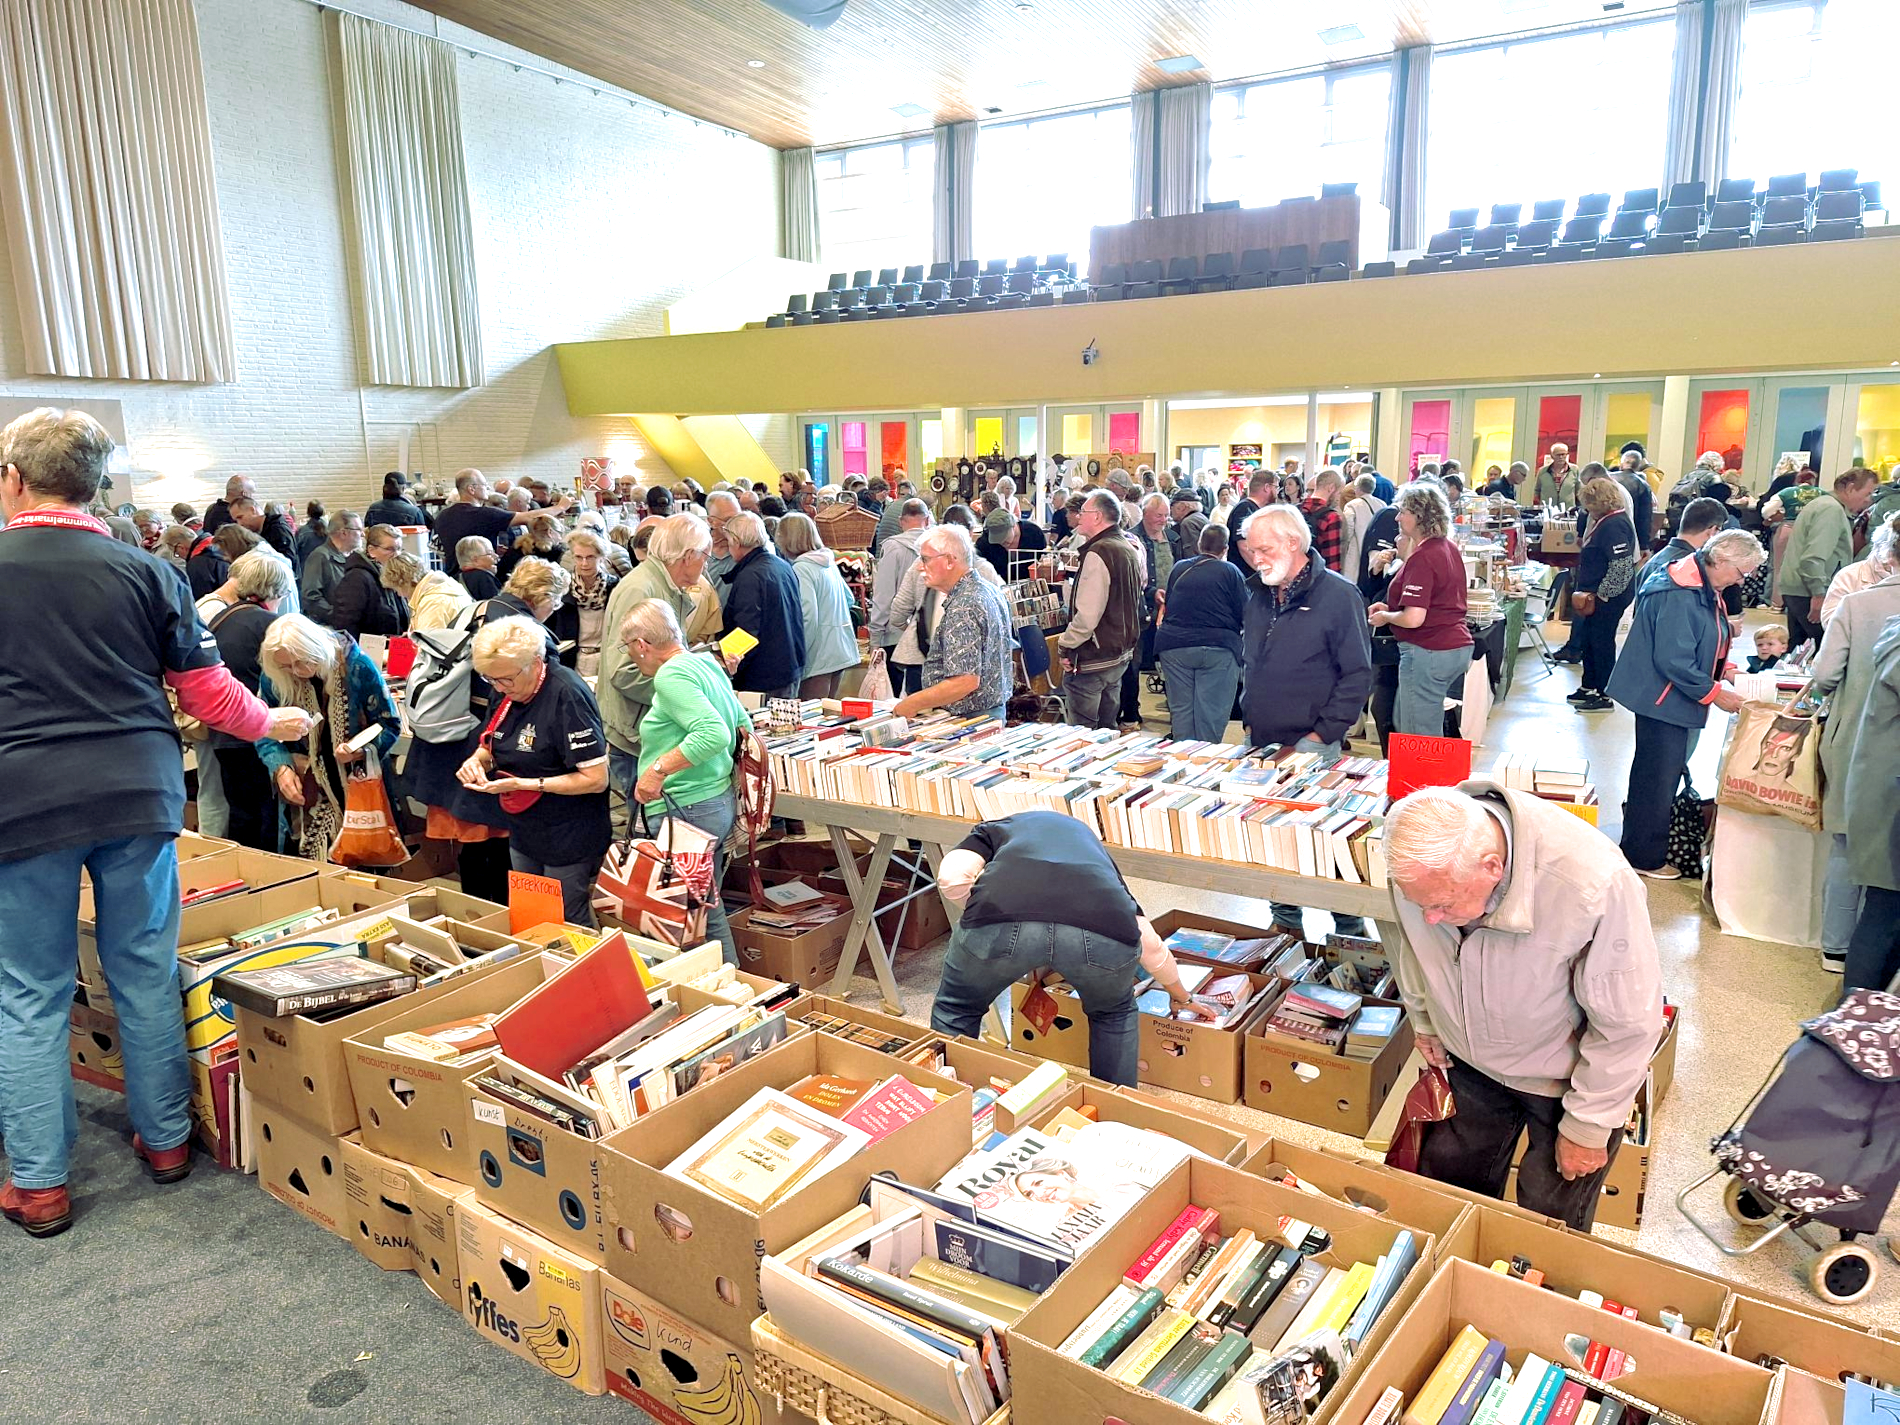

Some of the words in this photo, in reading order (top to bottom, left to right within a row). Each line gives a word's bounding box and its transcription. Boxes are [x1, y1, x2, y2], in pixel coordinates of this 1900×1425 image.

[1726, 775, 1758, 793] DAVID
[1758, 787, 1804, 805] BOWIE
[1772, 802, 1818, 817] MUSEUM
[303, 994, 338, 1009] BIJBEL
[1152, 1020, 1184, 1032] Produce
[1185, 1026, 1194, 1034] of
[1155, 1028, 1191, 1042] Colombia
[357, 1054, 389, 1070] PRODUCT
[390, 1063, 401, 1072] OF
[402, 1065, 443, 1081] COLOMBIA
[1260, 1044, 1297, 1060] PRODUCT
[1298, 1053, 1309, 1062] OF
[1309, 1056, 1352, 1071] COLOMBIA
[955, 1138, 1045, 1198] Royal
[307, 1206, 335, 1227] PRODUCT
[1166, 1223, 1184, 1241] Kelly
[374, 1232, 426, 1263] BANANAS
[945, 1247, 973, 1263] DROOM
[1191, 1243, 1217, 1275] Cornwell
[826, 1259, 874, 1284] Kokarde
[928, 1262, 979, 1286] Wilhelmina
[950, 1255, 971, 1269] VOOR
[613, 1299, 644, 1332] Dole
